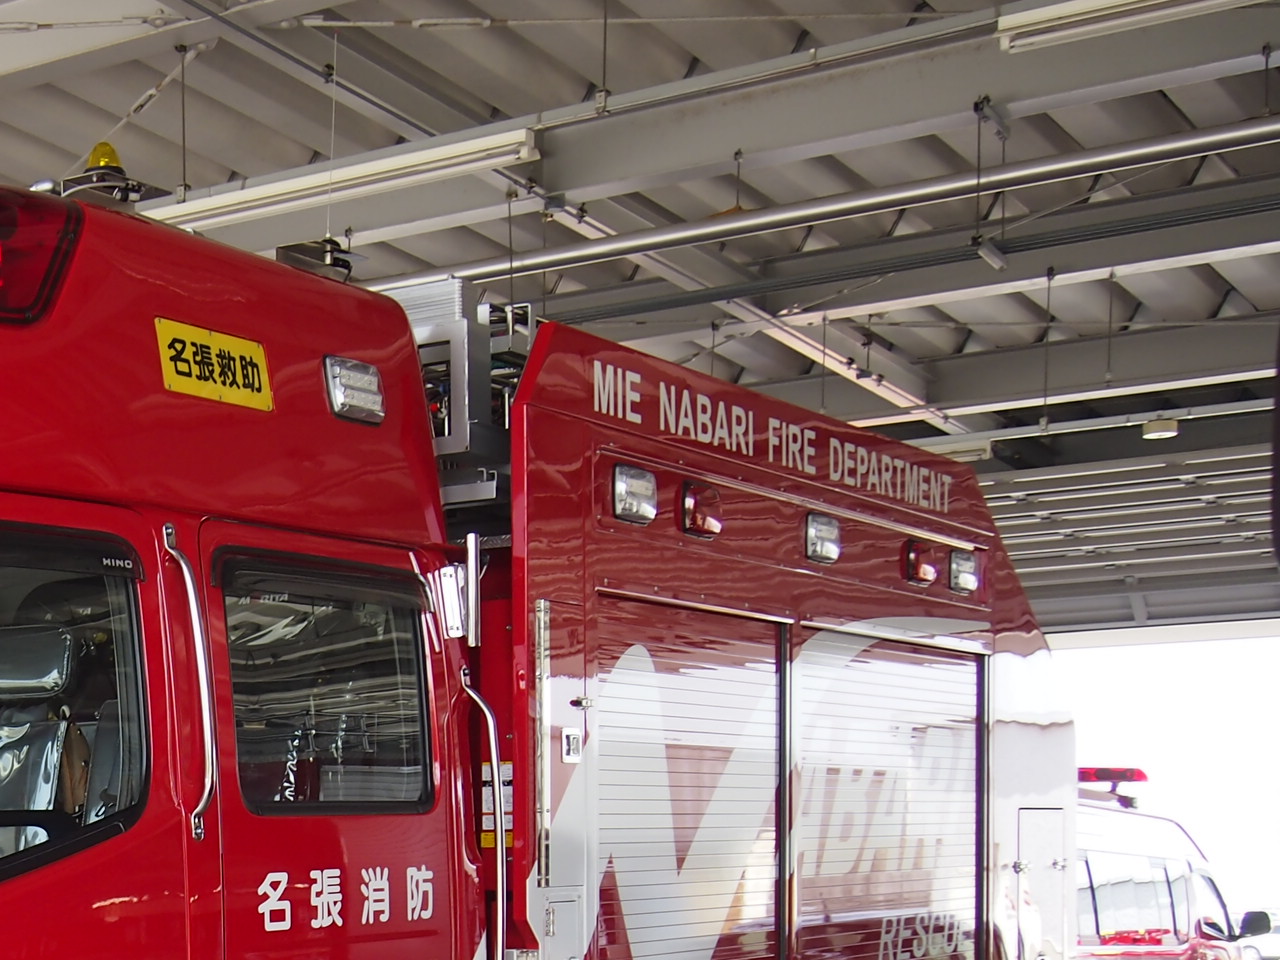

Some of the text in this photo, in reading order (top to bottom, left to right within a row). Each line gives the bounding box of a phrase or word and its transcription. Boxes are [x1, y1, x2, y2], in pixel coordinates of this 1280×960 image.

[167, 337, 263, 394] 名張救助
[593, 360, 953, 514] MIE NABARI FIRE DEPARTMENT
[102, 557, 133, 569] HINO
[257, 864, 434, 932] 名張消防
